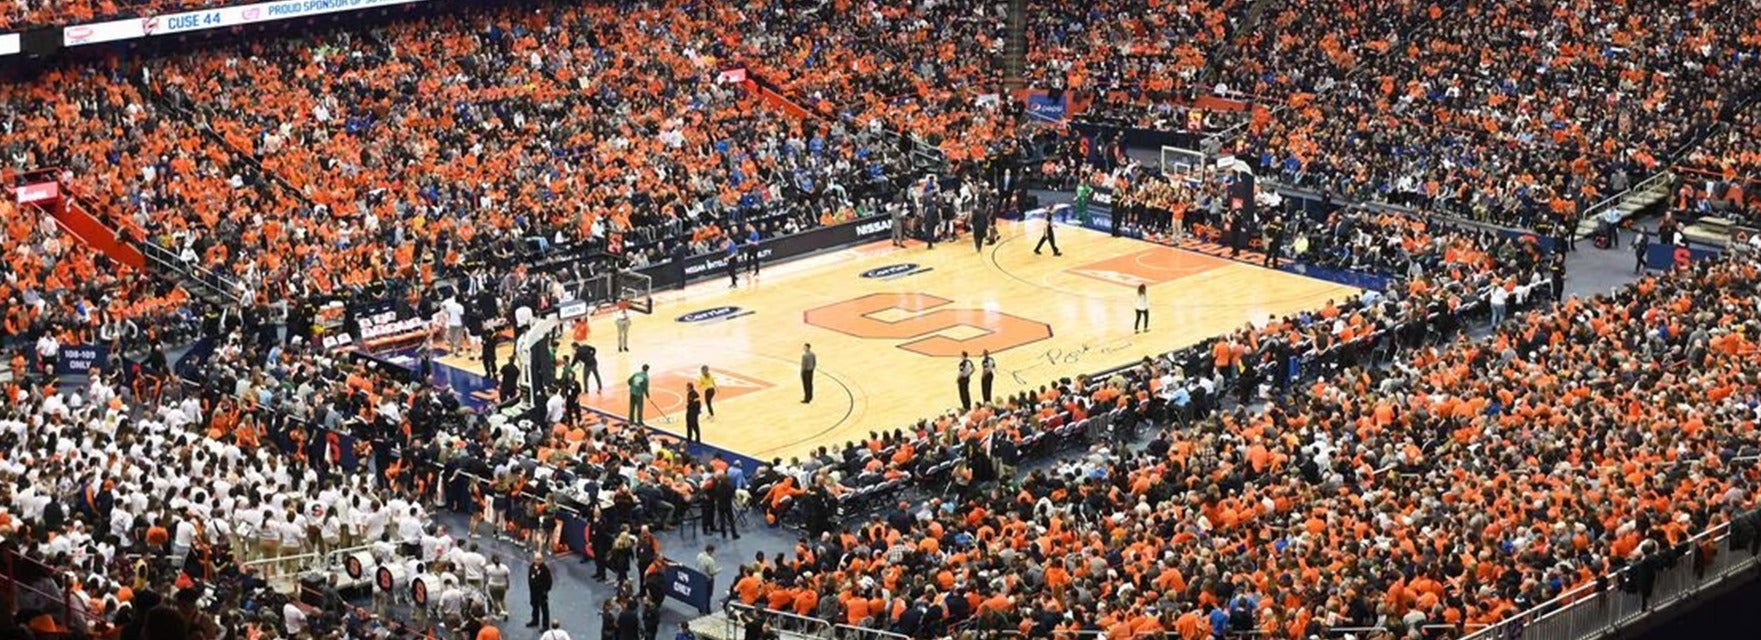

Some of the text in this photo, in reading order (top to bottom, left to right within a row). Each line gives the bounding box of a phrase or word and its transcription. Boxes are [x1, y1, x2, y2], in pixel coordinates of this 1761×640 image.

[268, 3, 301, 16] PROUD
[168, 12, 221, 30] CUSE 44
[69, 360, 91, 369] ONLY
